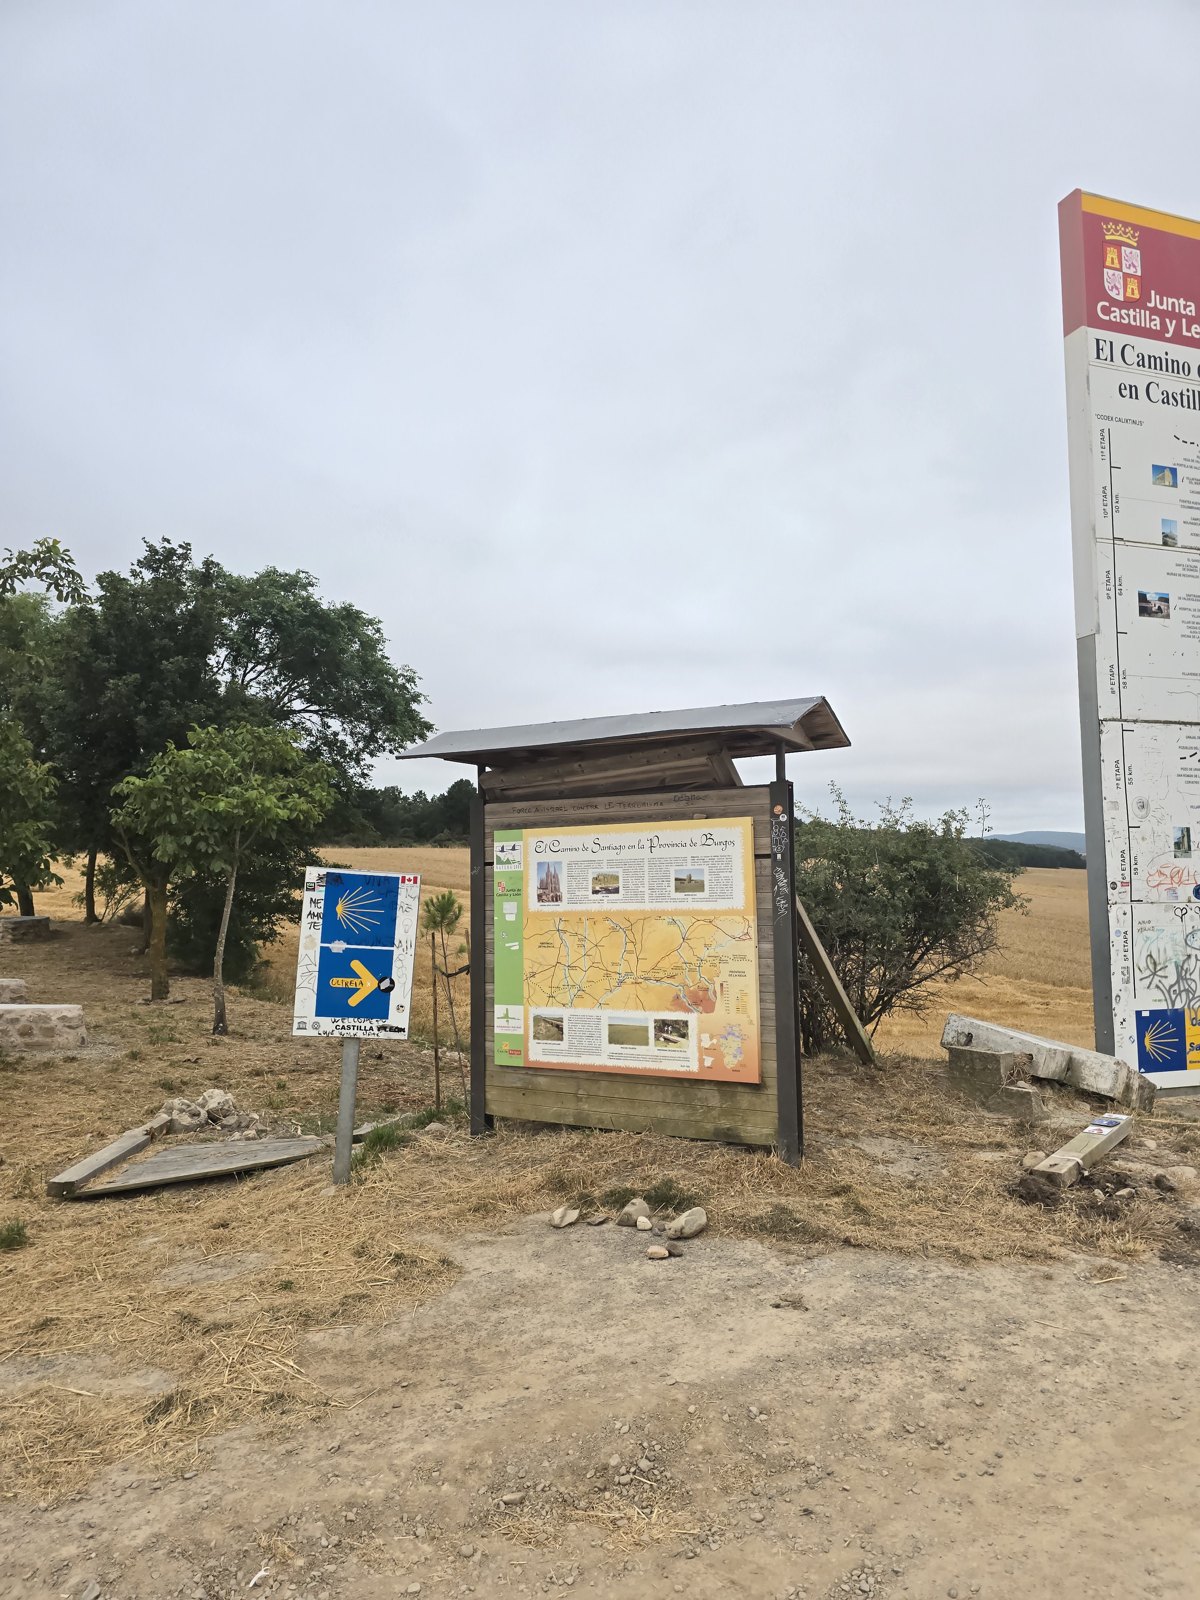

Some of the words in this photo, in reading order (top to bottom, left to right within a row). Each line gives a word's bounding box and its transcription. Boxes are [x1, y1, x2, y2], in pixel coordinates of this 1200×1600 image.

[1147, 290, 1196, 316] Junta
[1097, 302, 1160, 330] Castilla
[1165, 318, 1176, 338] y
[1182, 318, 1200, 338] Le
[1094, 338, 1114, 362] El
[1120, 344, 1191, 376] Camino
[1118, 382, 1140, 400] en
[1115, 504, 1120, 514] 50
[1128, 777, 1134, 785] 55
[535, 840, 548, 853] El
[549, 840, 580, 853] Camino
[582, 843, 589, 851] de
[591, 837, 626, 855] Santiago
[638, 839, 644, 850] la
[647, 835, 687, 853] Provincia
[689, 838, 698, 848] de
[700, 833, 736, 851] Burgos
[1134, 867, 1138, 876] 59
